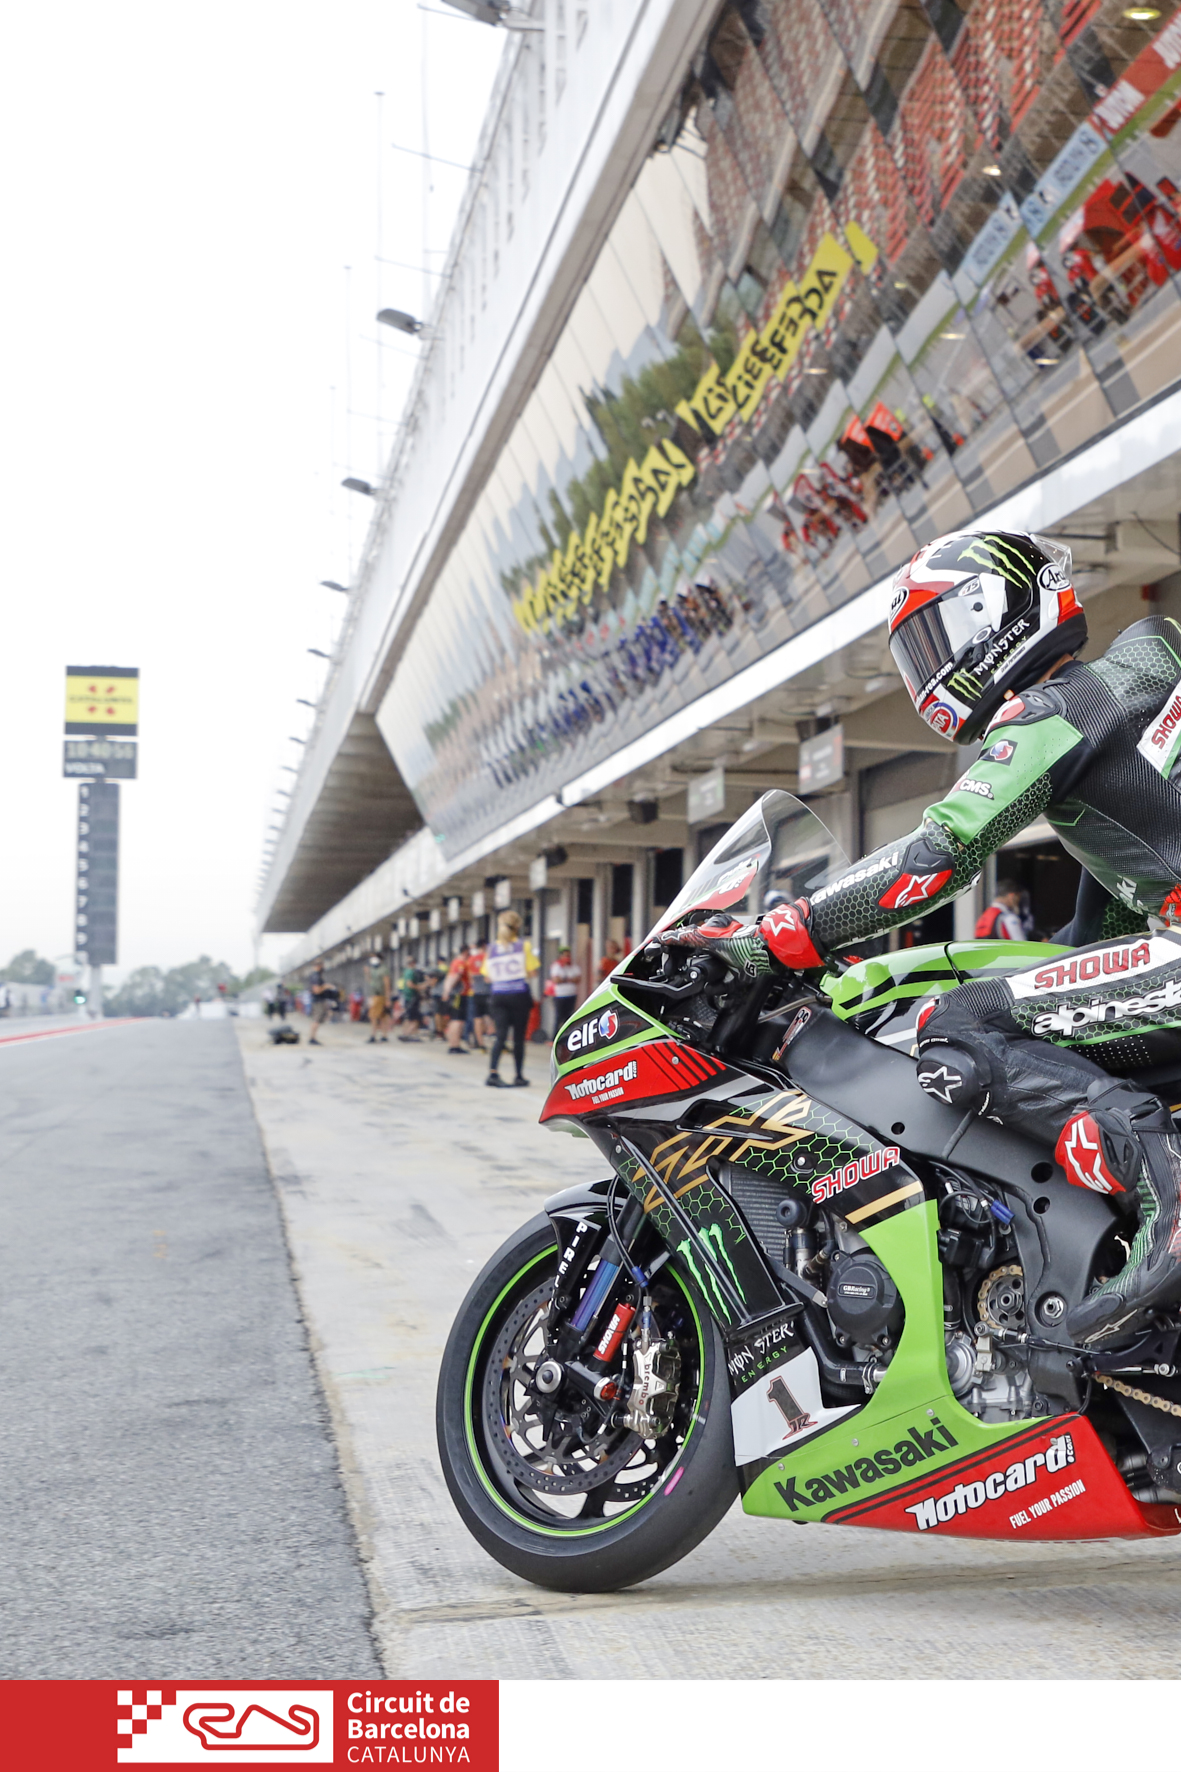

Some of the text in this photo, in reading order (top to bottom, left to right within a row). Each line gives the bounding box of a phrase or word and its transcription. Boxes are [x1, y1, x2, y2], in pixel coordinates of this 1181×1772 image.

[974, 619, 1030, 675] MONSTER
[1035, 942, 1151, 990] SHOWA
[567, 1018, 599, 1051] elf
[564, 1060, 634, 1101] Motocard
[811, 1146, 901, 1204] SHOWA
[598, 1313, 621, 1355] SHOWA
[639, 1363, 652, 1406] brembo
[741, 1346, 788, 1383] ENERGY
[766, 1375, 805, 1424] 1
[774, 1416, 960, 1512] Kawasaki
[904, 1434, 1068, 1531] Motocard
[1009, 1478, 1087, 1530] FUEL YOUR PASSION
